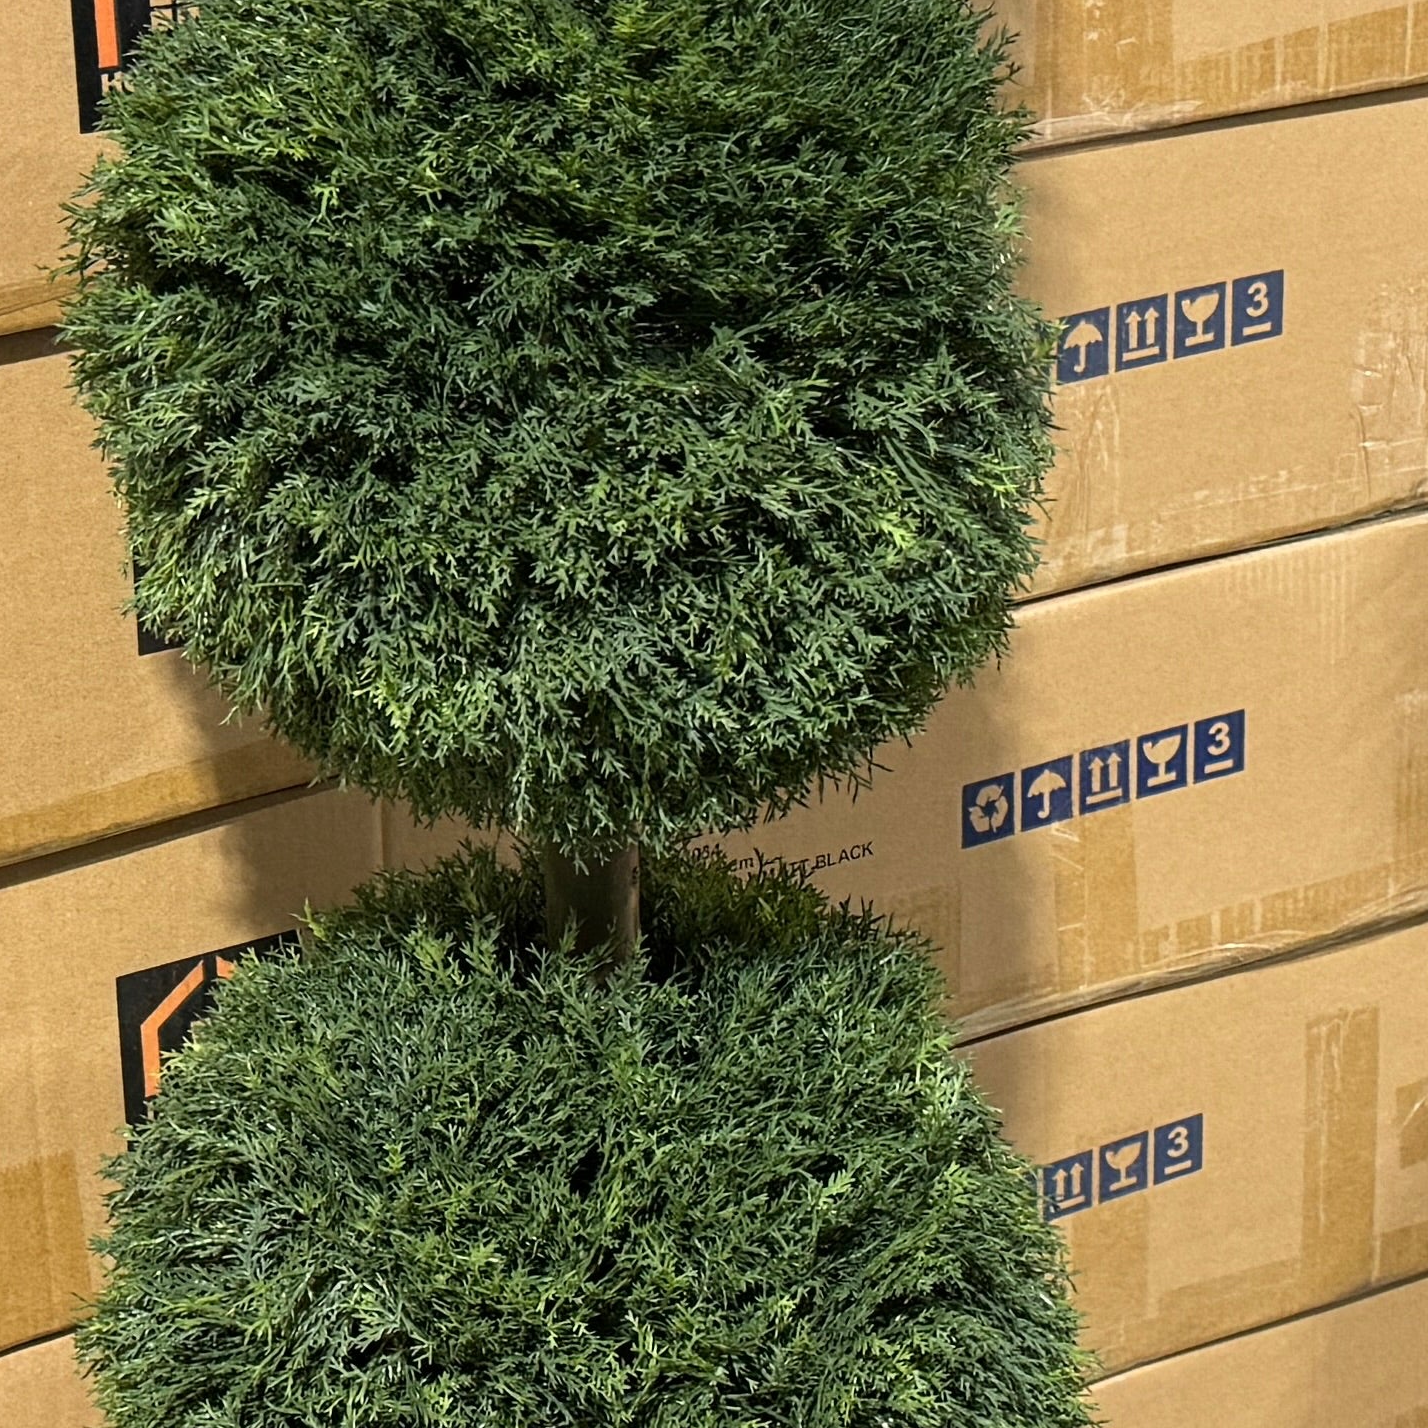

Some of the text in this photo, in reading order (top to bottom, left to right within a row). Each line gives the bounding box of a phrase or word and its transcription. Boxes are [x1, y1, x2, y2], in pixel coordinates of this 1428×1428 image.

[1245, 281, 1269, 319] 3
[1207, 721, 1231, 756] 3
[1166, 1126, 1189, 1158] 3
